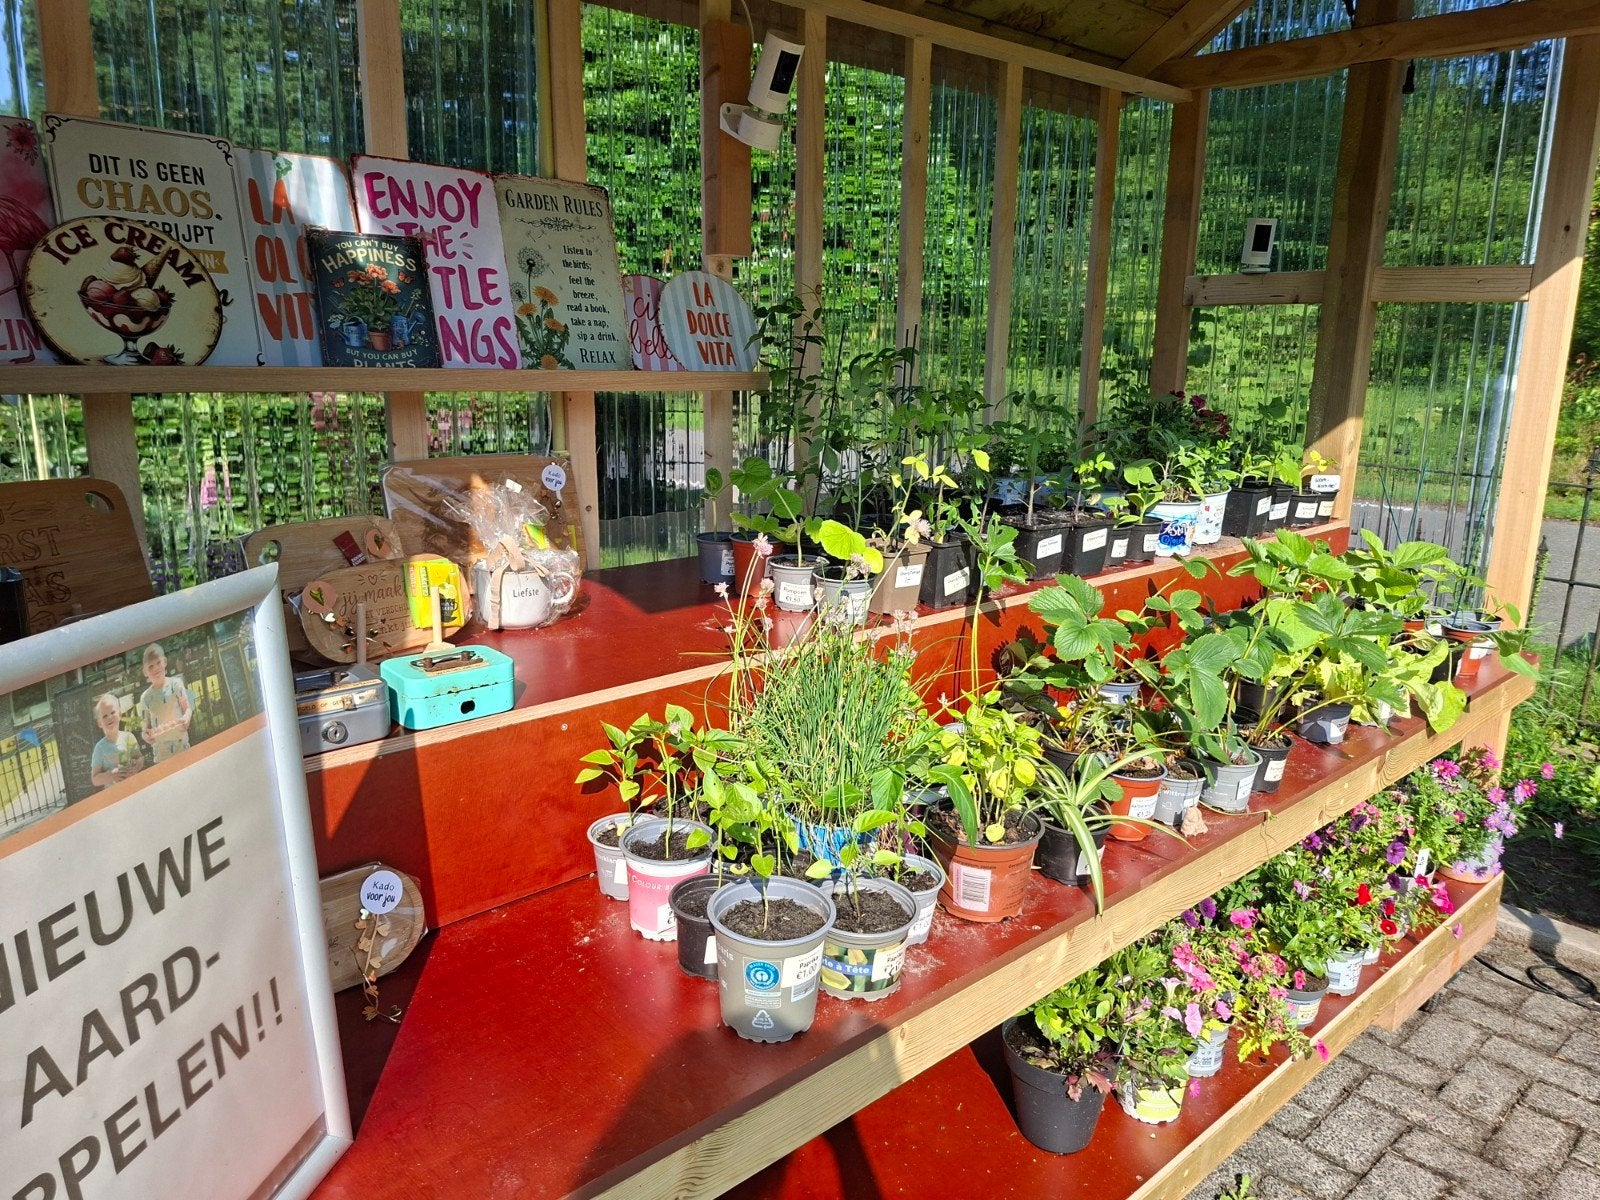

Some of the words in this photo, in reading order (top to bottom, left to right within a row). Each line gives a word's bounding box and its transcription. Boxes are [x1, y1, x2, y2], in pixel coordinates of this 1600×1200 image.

[89, 153, 121, 177] DIT
[129, 158, 149, 180] IS
[156, 162, 206, 187] GEEN
[76, 176, 224, 221] CHAOS.
[247, 177, 296, 226] LA
[363, 171, 483, 229] ENJOY
[505, 188, 559, 213] GARDEN
[562, 195, 604, 218] RULES
[336, 240, 352, 251] YOU
[354, 239, 379, 248] CAN'T
[381, 242, 399, 252] BUY
[396, 222, 457, 260] THE
[42, 224, 99, 266] ICE
[104, 222, 207, 289] CREAM
[563, 245, 585, 256] Listen
[586, 246, 593, 256] to
[321, 247, 417, 274] HAPPINESS
[562, 260, 573, 270] the
[568, 276, 583, 286] feel
[584, 277, 596, 287] the
[573, 290, 599, 301] breeze,
[692, 281, 715, 307] LA
[256, 292, 315, 341] VIT
[567, 304, 583, 313] read
[584, 305, 590, 313] a
[591, 303, 610, 315] book,
[571, 317, 586, 327] take
[593, 319, 609, 330] nap,
[686, 309, 733, 339] DOLCE
[577, 331, 588, 342] sip
[590, 333, 596, 341] a
[346, 347, 361, 358] BUT
[362, 351, 381, 361] YOU
[382, 352, 400, 361] CAN
[401, 348, 419, 360] BUY
[578, 347, 617, 365] RELAX
[696, 340, 737, 367] VITA
[0, 525, 61, 566] RST
[512, 588, 539, 598] Liefste
[373, 881, 395, 891] Kado
[366, 891, 383, 901] voor
[382, 893, 396, 908] jou
[799, 955, 819, 968] Paprika
[823, 957, 834, 969] te
[846, 963, 870, 975] Tête
[20, 946, 221, 1130] AARD-
